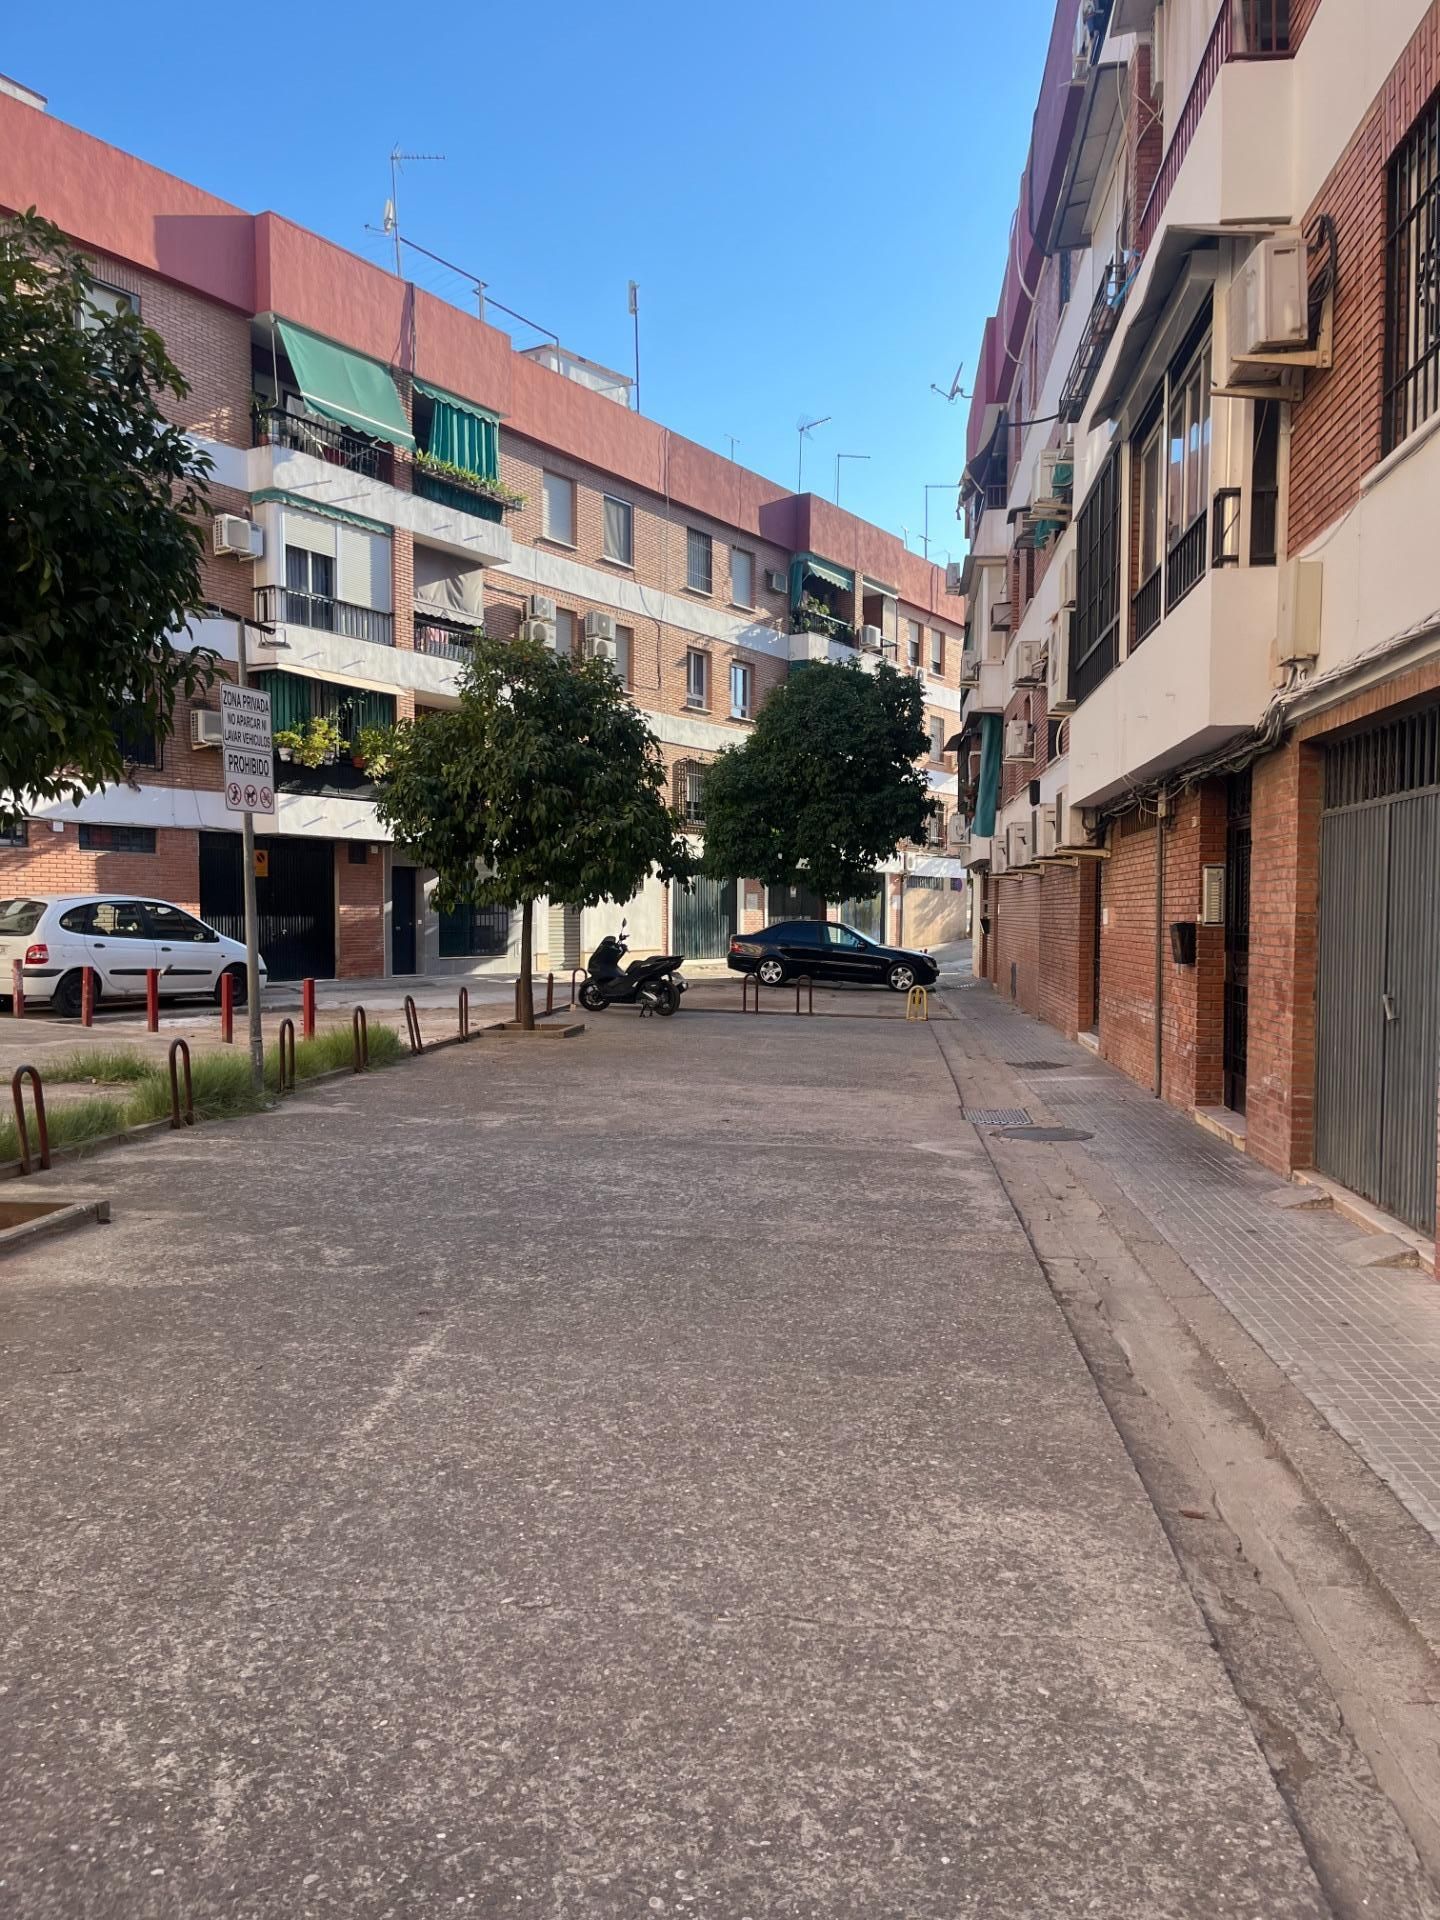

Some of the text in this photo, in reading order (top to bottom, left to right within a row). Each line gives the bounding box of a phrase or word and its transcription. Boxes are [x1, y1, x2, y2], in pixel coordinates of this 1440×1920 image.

[223, 690, 269, 713] ZONA PRIVADA
[227, 713, 267, 731] NO APARCAR NI
[225, 728, 271, 748] LAVAR VEHICULOS
[228, 754, 270, 776] PROHIBIDO
